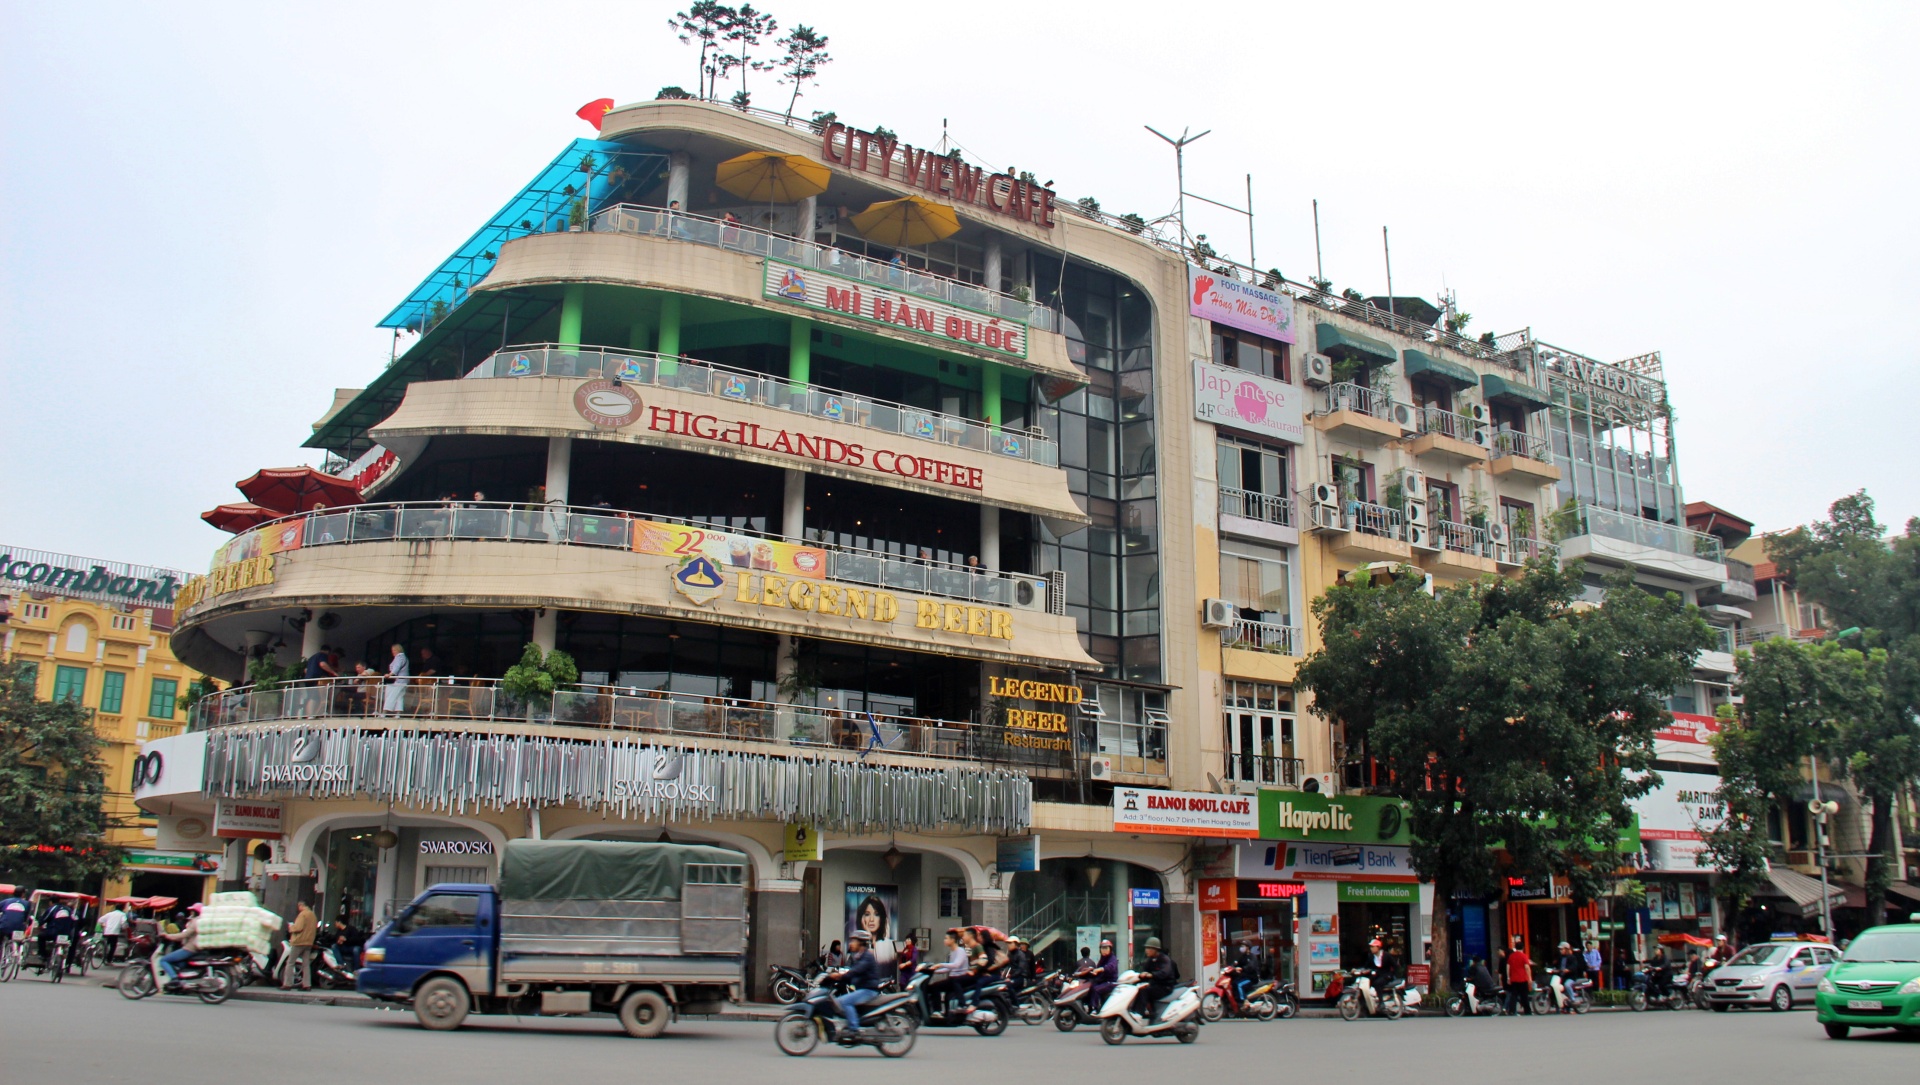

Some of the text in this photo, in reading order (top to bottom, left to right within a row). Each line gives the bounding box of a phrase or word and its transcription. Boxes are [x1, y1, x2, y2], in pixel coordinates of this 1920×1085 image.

[823, 122, 1056, 228] CITY VIEW CAFÉ
[1221, 279, 1279, 304] FOOT MASSAGE
[826, 285, 1018, 353] MÌ HÀN QUỐC
[1200, 366, 1285, 408] Japanese
[1565, 356, 1643, 399] AVALON
[583, 408, 631, 426] COFFEE
[1198, 402, 1215, 418] 4F
[1217, 404, 1240, 419] Cafe
[1249, 411, 1302, 435] Restaurant
[648, 405, 983, 491] HIGHLANDS COFFEE
[673, 530, 705, 555] 22
[210, 554, 275, 598] BEER
[736, 571, 1015, 640] LEGEND BEER
[988, 675, 1083, 704] LEGEND
[1006, 708, 1068, 733] BEER
[1003, 732, 1072, 751] Restaurant
[261, 764, 348, 782] SWAROVSKI
[615, 780, 716, 802] SWAROVSKI
[1677, 790, 1724, 804] MARITIM
[1147, 796, 1250, 814] HANOI SOUL CAFÉ
[1699, 807, 1723, 820] BANK
[1211, 819, 1231, 827] Hoang
[1279, 801, 1353, 836] HaproTic
[420, 840, 492, 855] SWAROVSKI
[1303, 846, 1396, 871] TienPg Bank
[846, 885, 876, 893] SWAROVSKI
[1347, 886, 1410, 897] Free information
[1511, 887, 1547, 898] Restaurant
